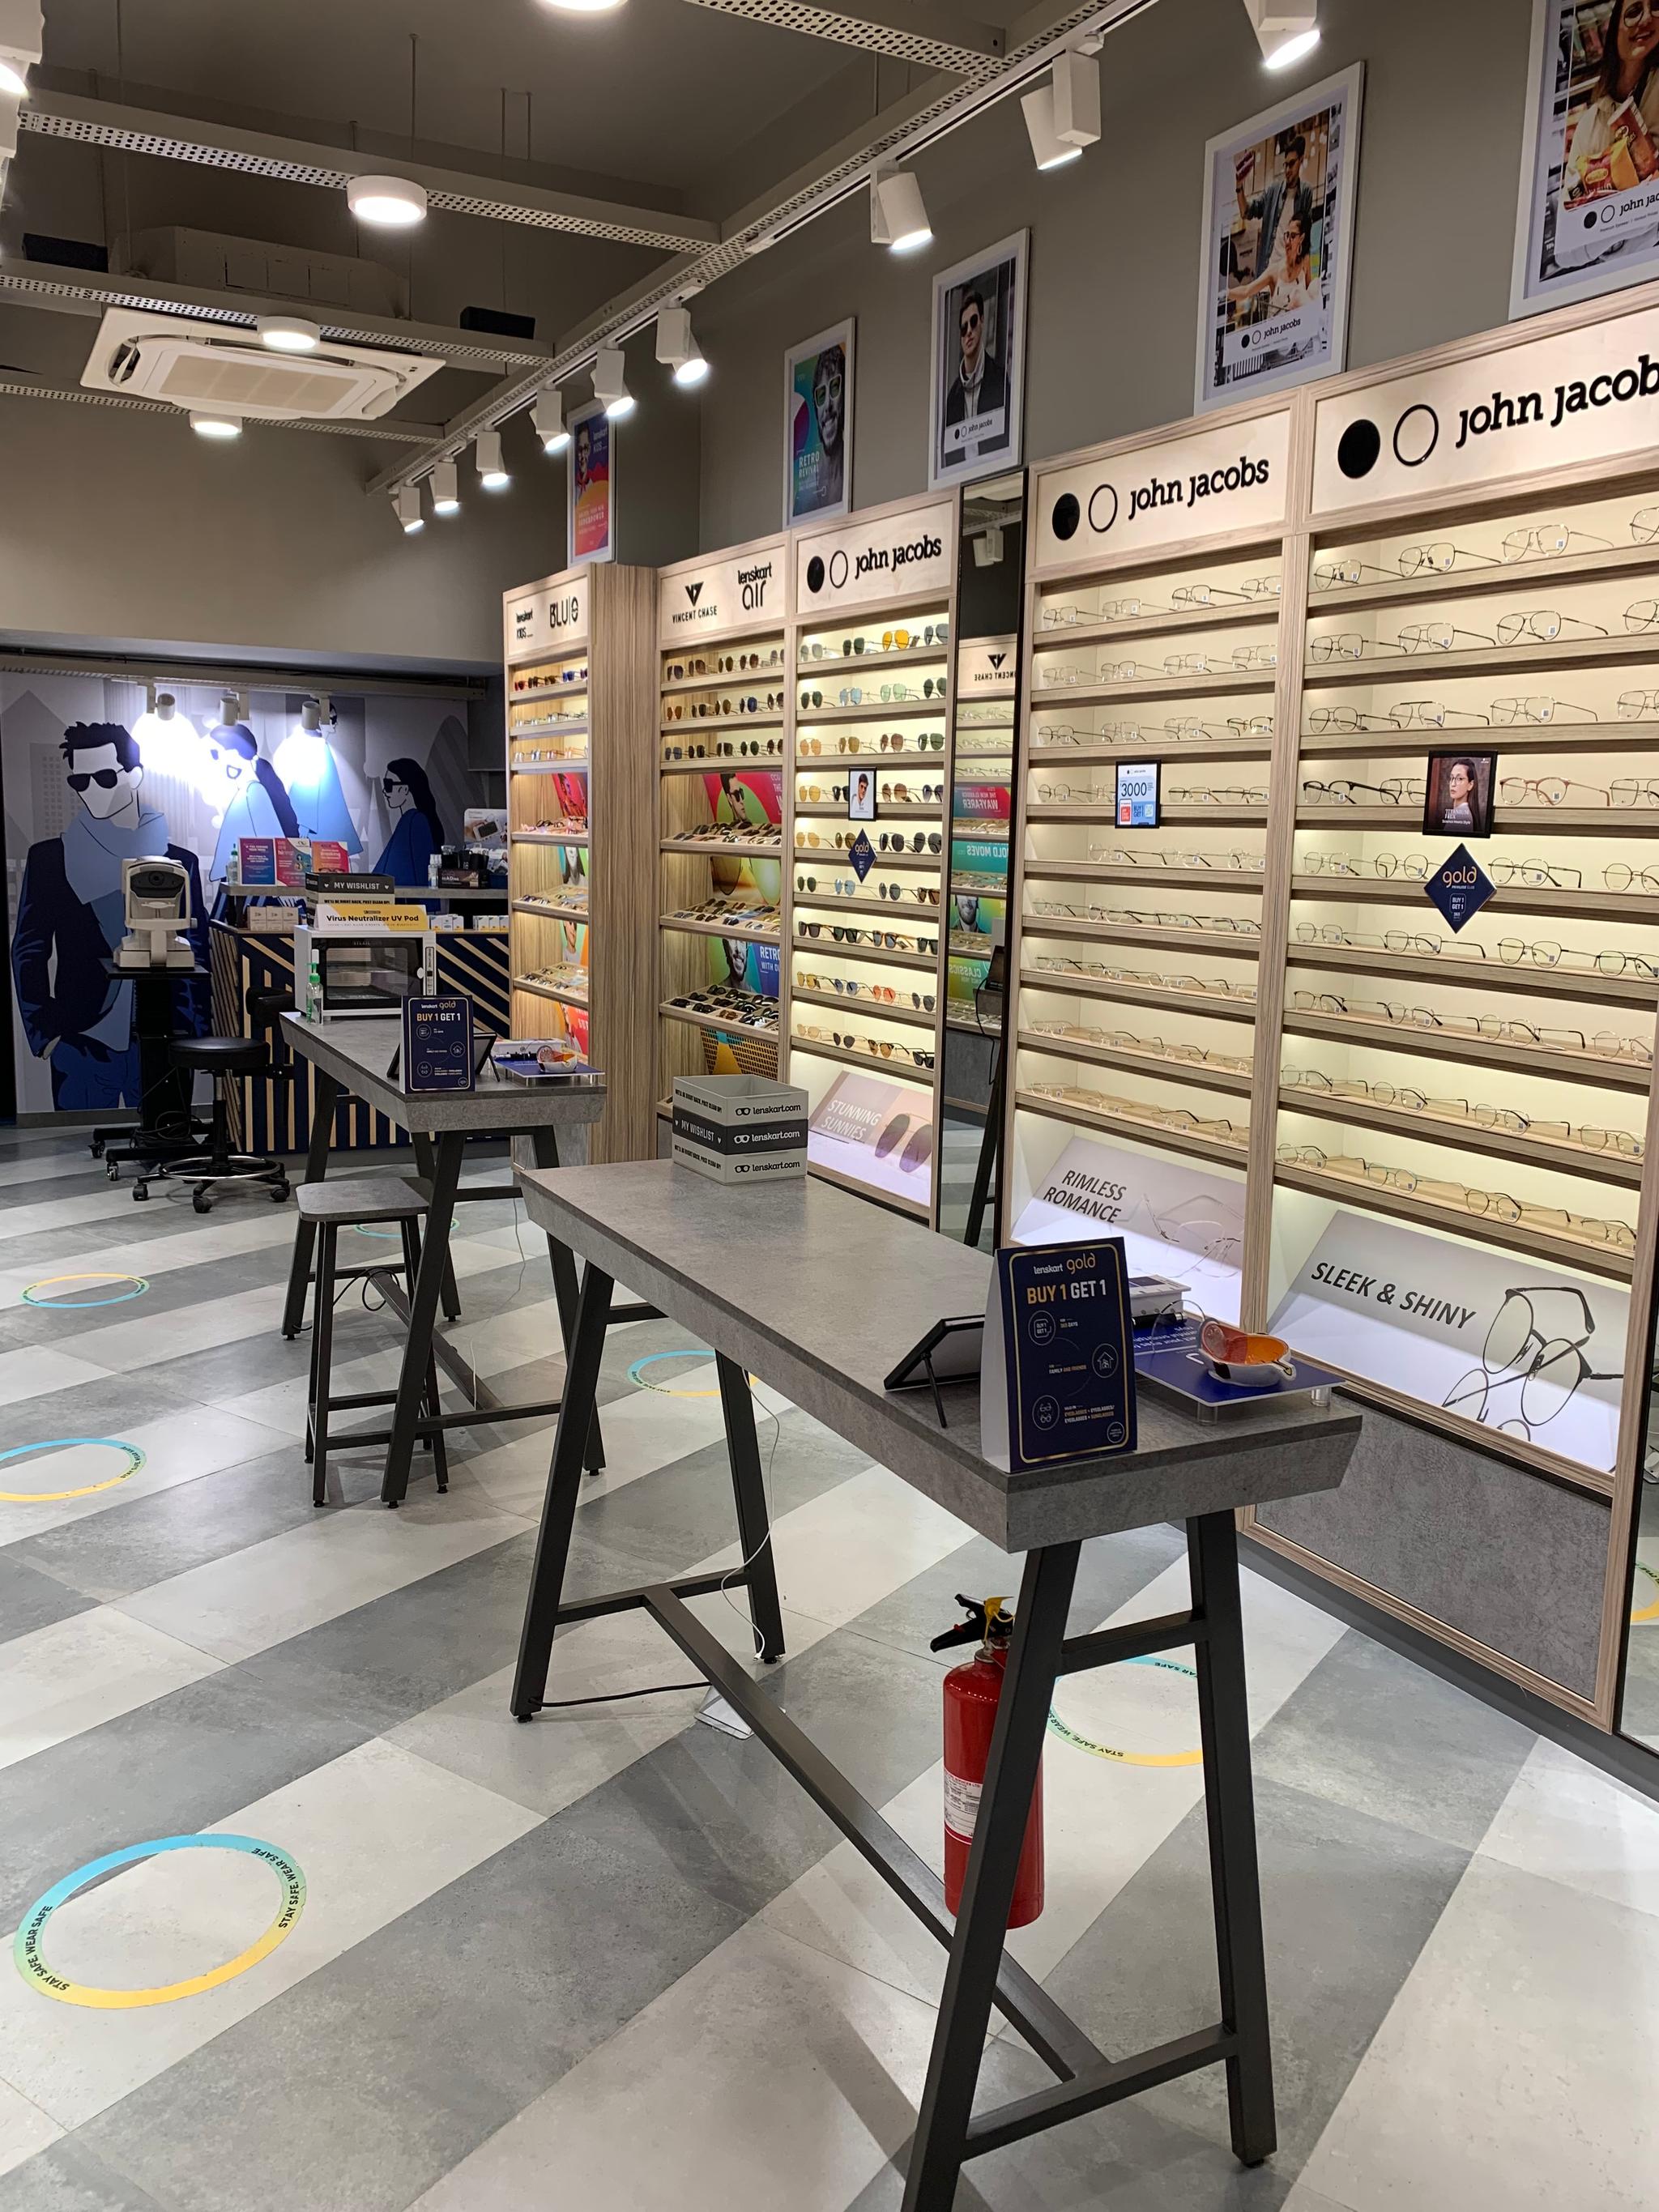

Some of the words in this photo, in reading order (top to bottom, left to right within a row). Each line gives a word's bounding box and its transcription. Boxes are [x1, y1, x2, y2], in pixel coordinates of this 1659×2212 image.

[1619, 198, 1644, 216] john
[1645, 193, 1659, 207] jac
[1263, 326, 1279, 339] john
[1280, 318, 1301, 334] jacobs
[1456, 391, 1543, 449] john
[1550, 354, 1659, 428] jacob
[799, 450, 820, 468] RETRO
[1128, 477, 1183, 521] john
[1187, 455, 1269, 508] jacobs
[855, 547, 889, 580] john
[891, 534, 941, 573] jacobs
[738, 561, 772, 585] lenskart
[742, 579, 766, 611] air
[672, 609, 696, 624] VINCENT
[697, 605, 718, 618] CHASE
[1121, 782, 1147, 797] 3000
[855, 842, 869, 855] gold
[347, 882, 380, 890] WISHLIST
[1443, 866, 1478, 888] gold
[761, 961, 774, 970] WITH
[439, 1000, 456, 1010] gold
[416, 1013, 433, 1021] BUY
[434, 1013, 438, 1021] 1
[440, 1012, 456, 1021] GET
[457, 1012, 461, 1021] 1
[753, 1103, 801, 1115] lenskart.com
[827, 1099, 881, 1126] STUNNING
[681, 1119, 689, 1131] MY
[690, 1122, 714, 1142] WISHLIST
[752, 1131, 800, 1142] lenskart.com
[821, 1116, 866, 1140] SUNNIES
[752, 1161, 800, 1172] lenskart.com
[1061, 1170, 1127, 1201] RIMLESS
[1043, 1186, 1122, 1224] ROMANCE
[1033, 1264, 1063, 1275] lenskart
[1066, 1252, 1096, 1275] gold
[1026, 1285, 1056, 1305] BUY
[1060, 1284, 1067, 1300] 1
[1070, 1281, 1097, 1299] GET
[1100, 1279, 1107, 1296] 1
[1311, 1262, 1377, 1298] SLEEK
[1376, 1283, 1397, 1306] &
[1399, 1291, 1477, 1329] SHINY
[1154, 1662, 1180, 1671] SAFE
[1051, 1719, 1072, 1737] WEAR
[1098, 1747, 1124, 1758] STAY
[251, 1848, 279, 1862] SAFE
[275, 1860, 296, 1882] WEAR
[31, 1906, 53, 1928] SAFE
[279, 1907, 296, 1929] STAY
[25, 1929, 39, 1955] WEAR
[41, 1975, 70, 1991] STAY
